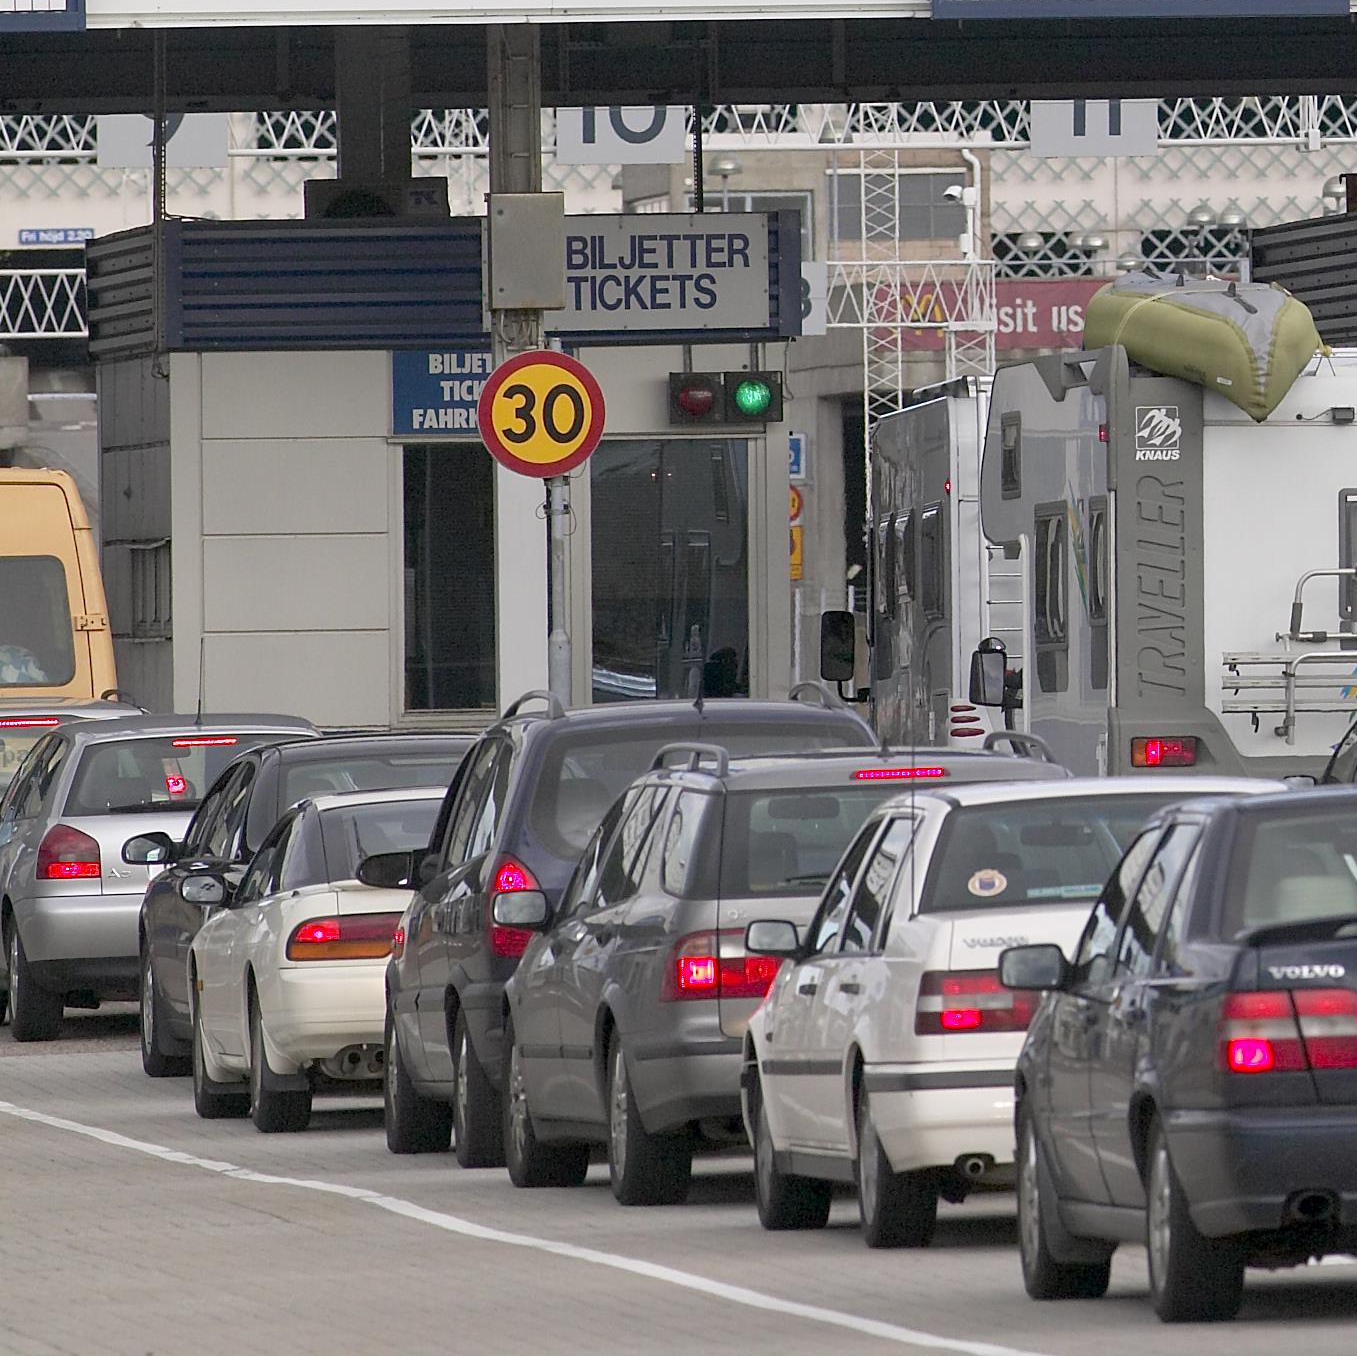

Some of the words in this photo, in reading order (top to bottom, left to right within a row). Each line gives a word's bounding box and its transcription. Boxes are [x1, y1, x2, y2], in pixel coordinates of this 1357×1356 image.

[566, 233, 750, 270] BILJETTER
[566, 273, 717, 311] TICKETS
[1051, 304, 1085, 333] us
[502, 384, 585, 443] 30
[1135, 449, 1181, 461] KNAUS
[1136, 475, 1186, 697] TRAVELLER
[1267, 964, 1346, 980] VOLVO
